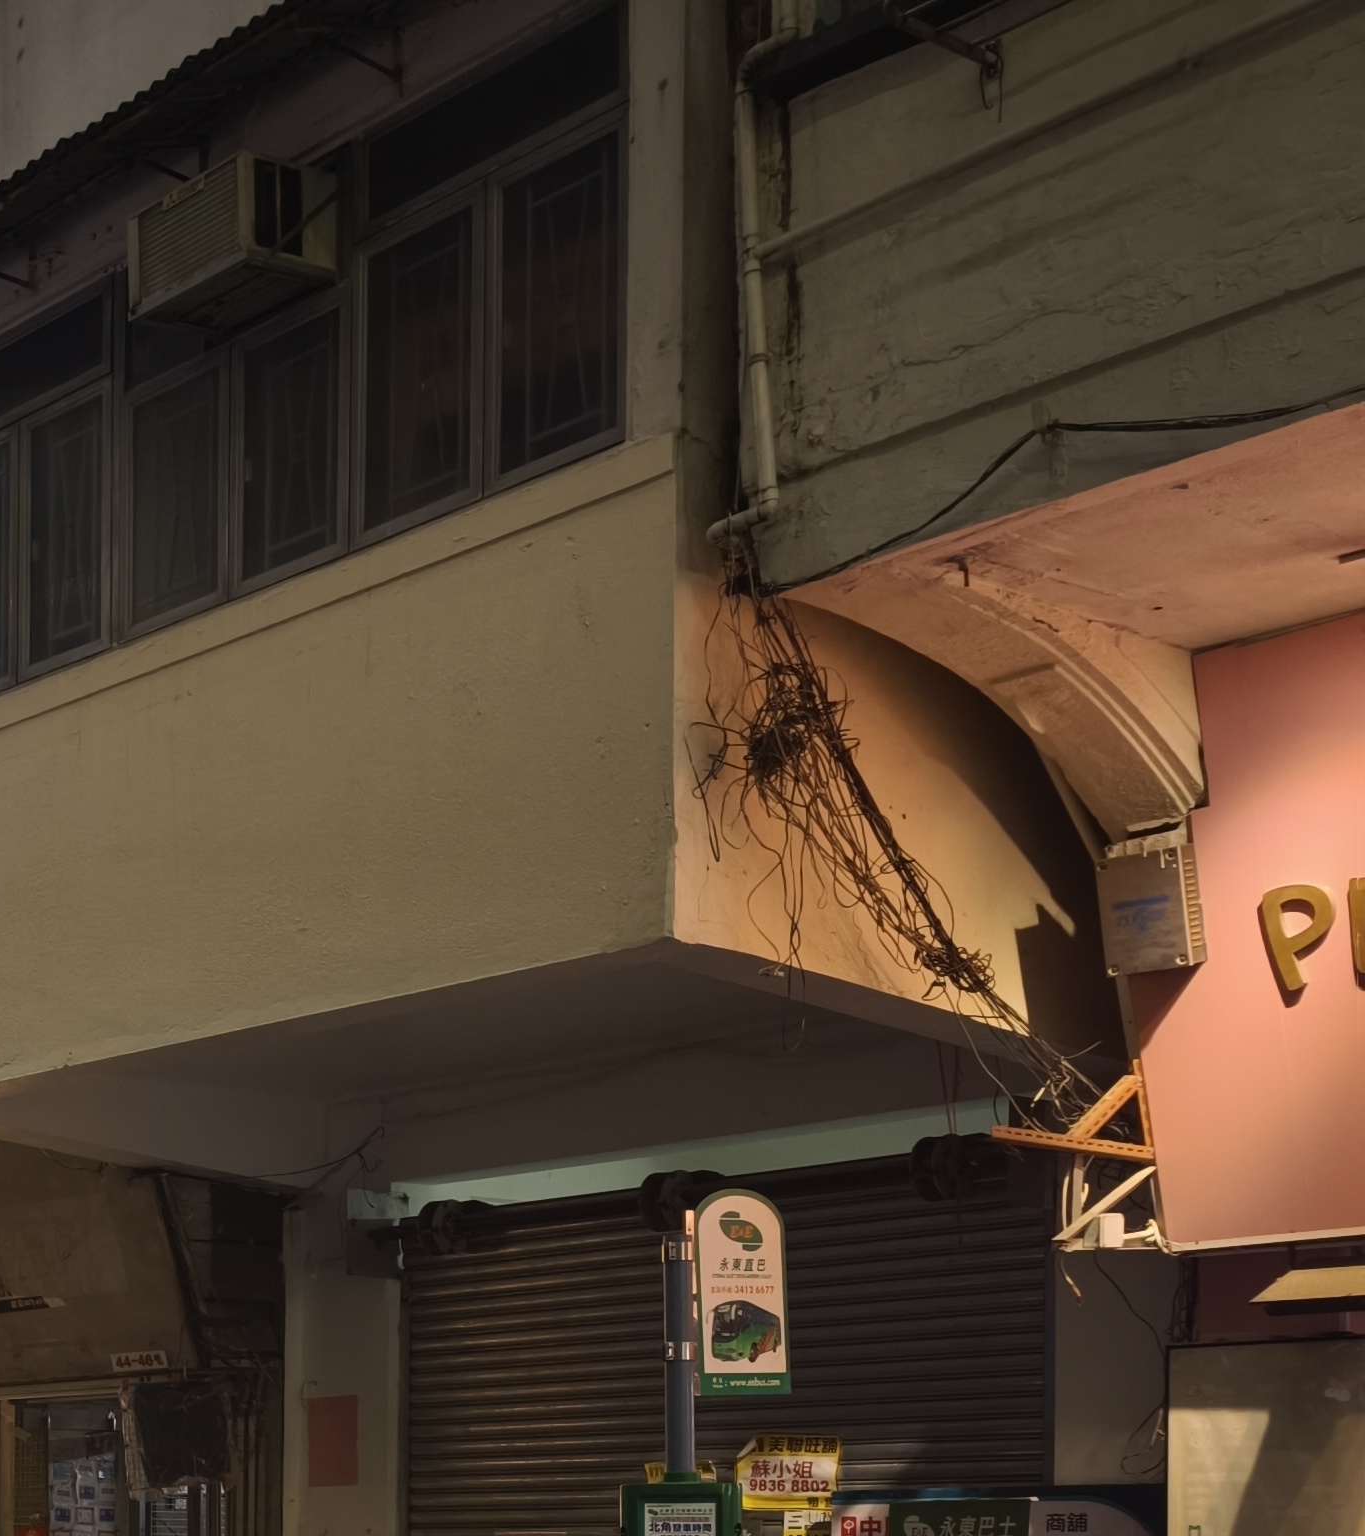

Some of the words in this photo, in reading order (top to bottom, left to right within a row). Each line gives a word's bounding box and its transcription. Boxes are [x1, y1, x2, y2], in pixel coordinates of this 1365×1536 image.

[751, 1459, 813, 1479] 蘇小姐
[749, 1479, 786, 1492] 9836
[791, 1480, 830, 1493] 8802
[1046, 1513, 1088, 1533] 商舖
